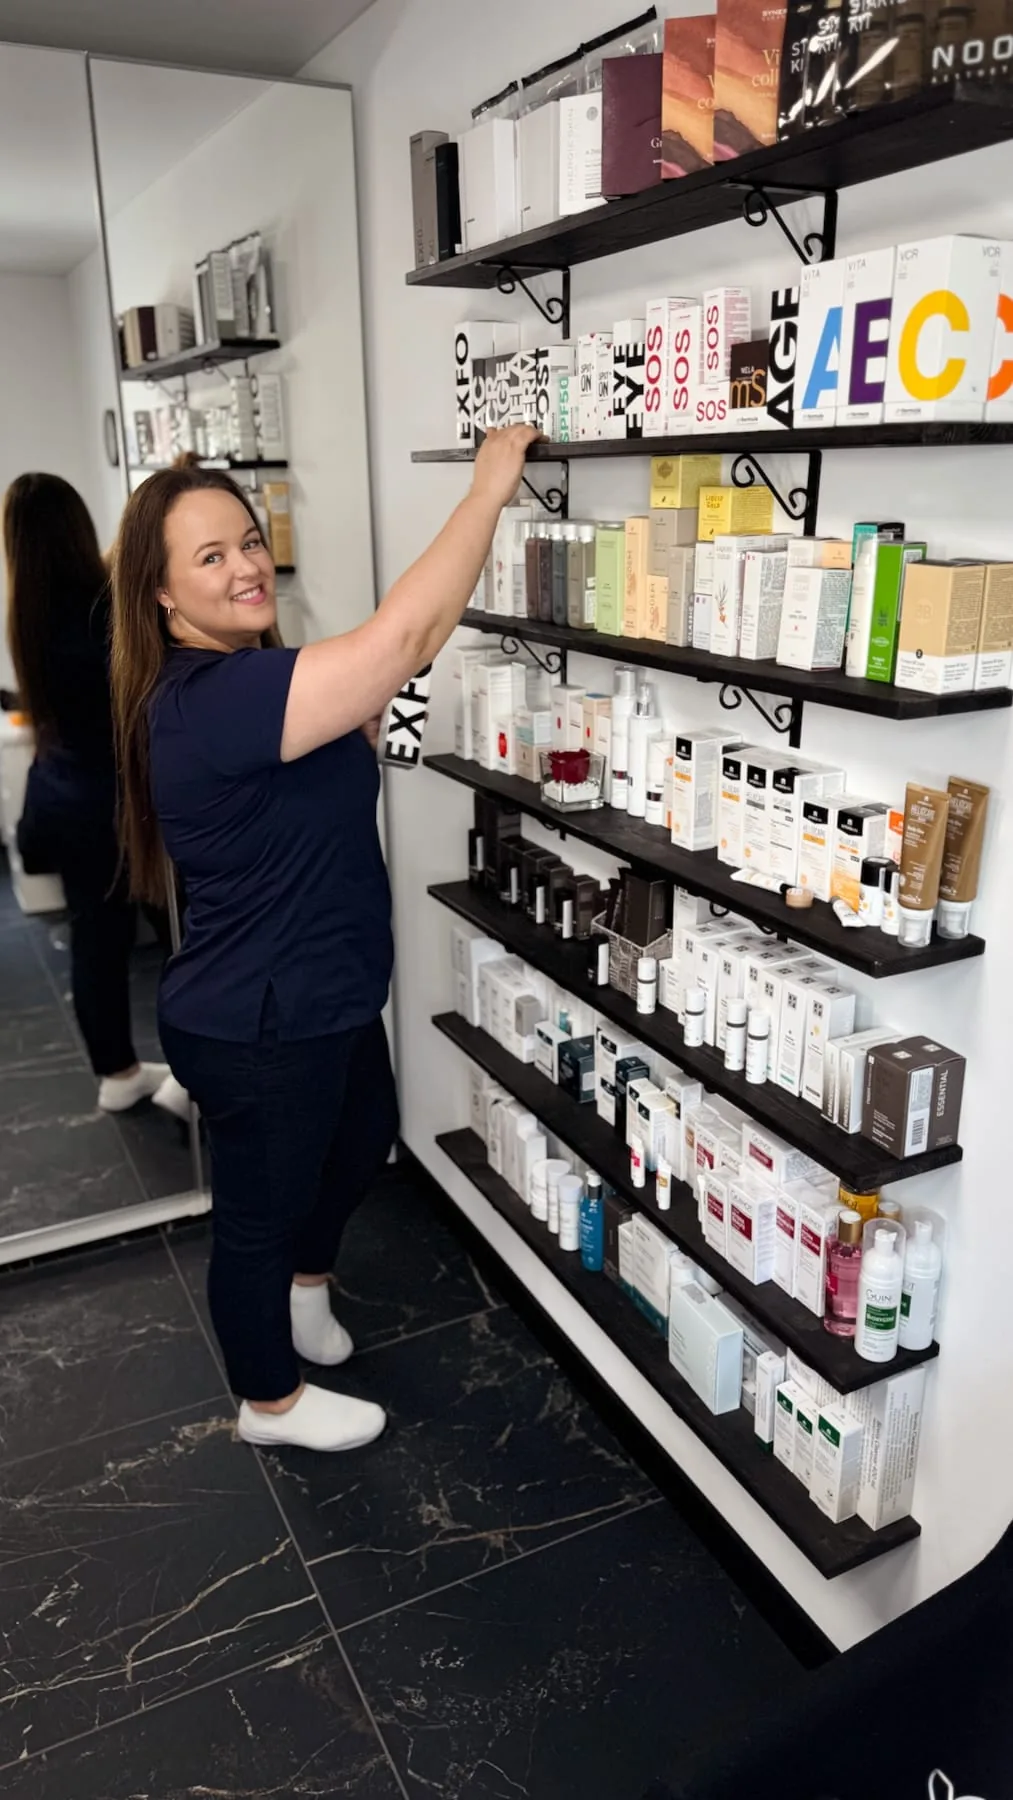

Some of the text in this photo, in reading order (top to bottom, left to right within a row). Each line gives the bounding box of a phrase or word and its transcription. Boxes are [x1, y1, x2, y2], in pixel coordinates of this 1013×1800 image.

[932, 34, 1013, 70] NOO
[803, 269, 821, 281] VITA
[848, 258, 867, 272] VITA
[581, 364, 592, 374] SPOT
[645, 325, 663, 412] SOS
[673, 329, 690, 410] SOS
[706, 305, 719, 370] SOS
[767, 285, 800, 430] AGE
[848, 297, 892, 405] E
[898, 289, 970, 401] C
[455, 332, 471, 440] EXFO
[581, 375, 592, 392] ON
[598, 382, 609, 397] ON
[599, 371, 609, 383] SPOT
[613, 345, 626, 416] EYE
[626, 343, 645, 438] EYE
[560, 377, 570, 443] SPF50
[696, 400, 727, 422] SOS
[936, 1070, 949, 1117] ESSENTIAL
